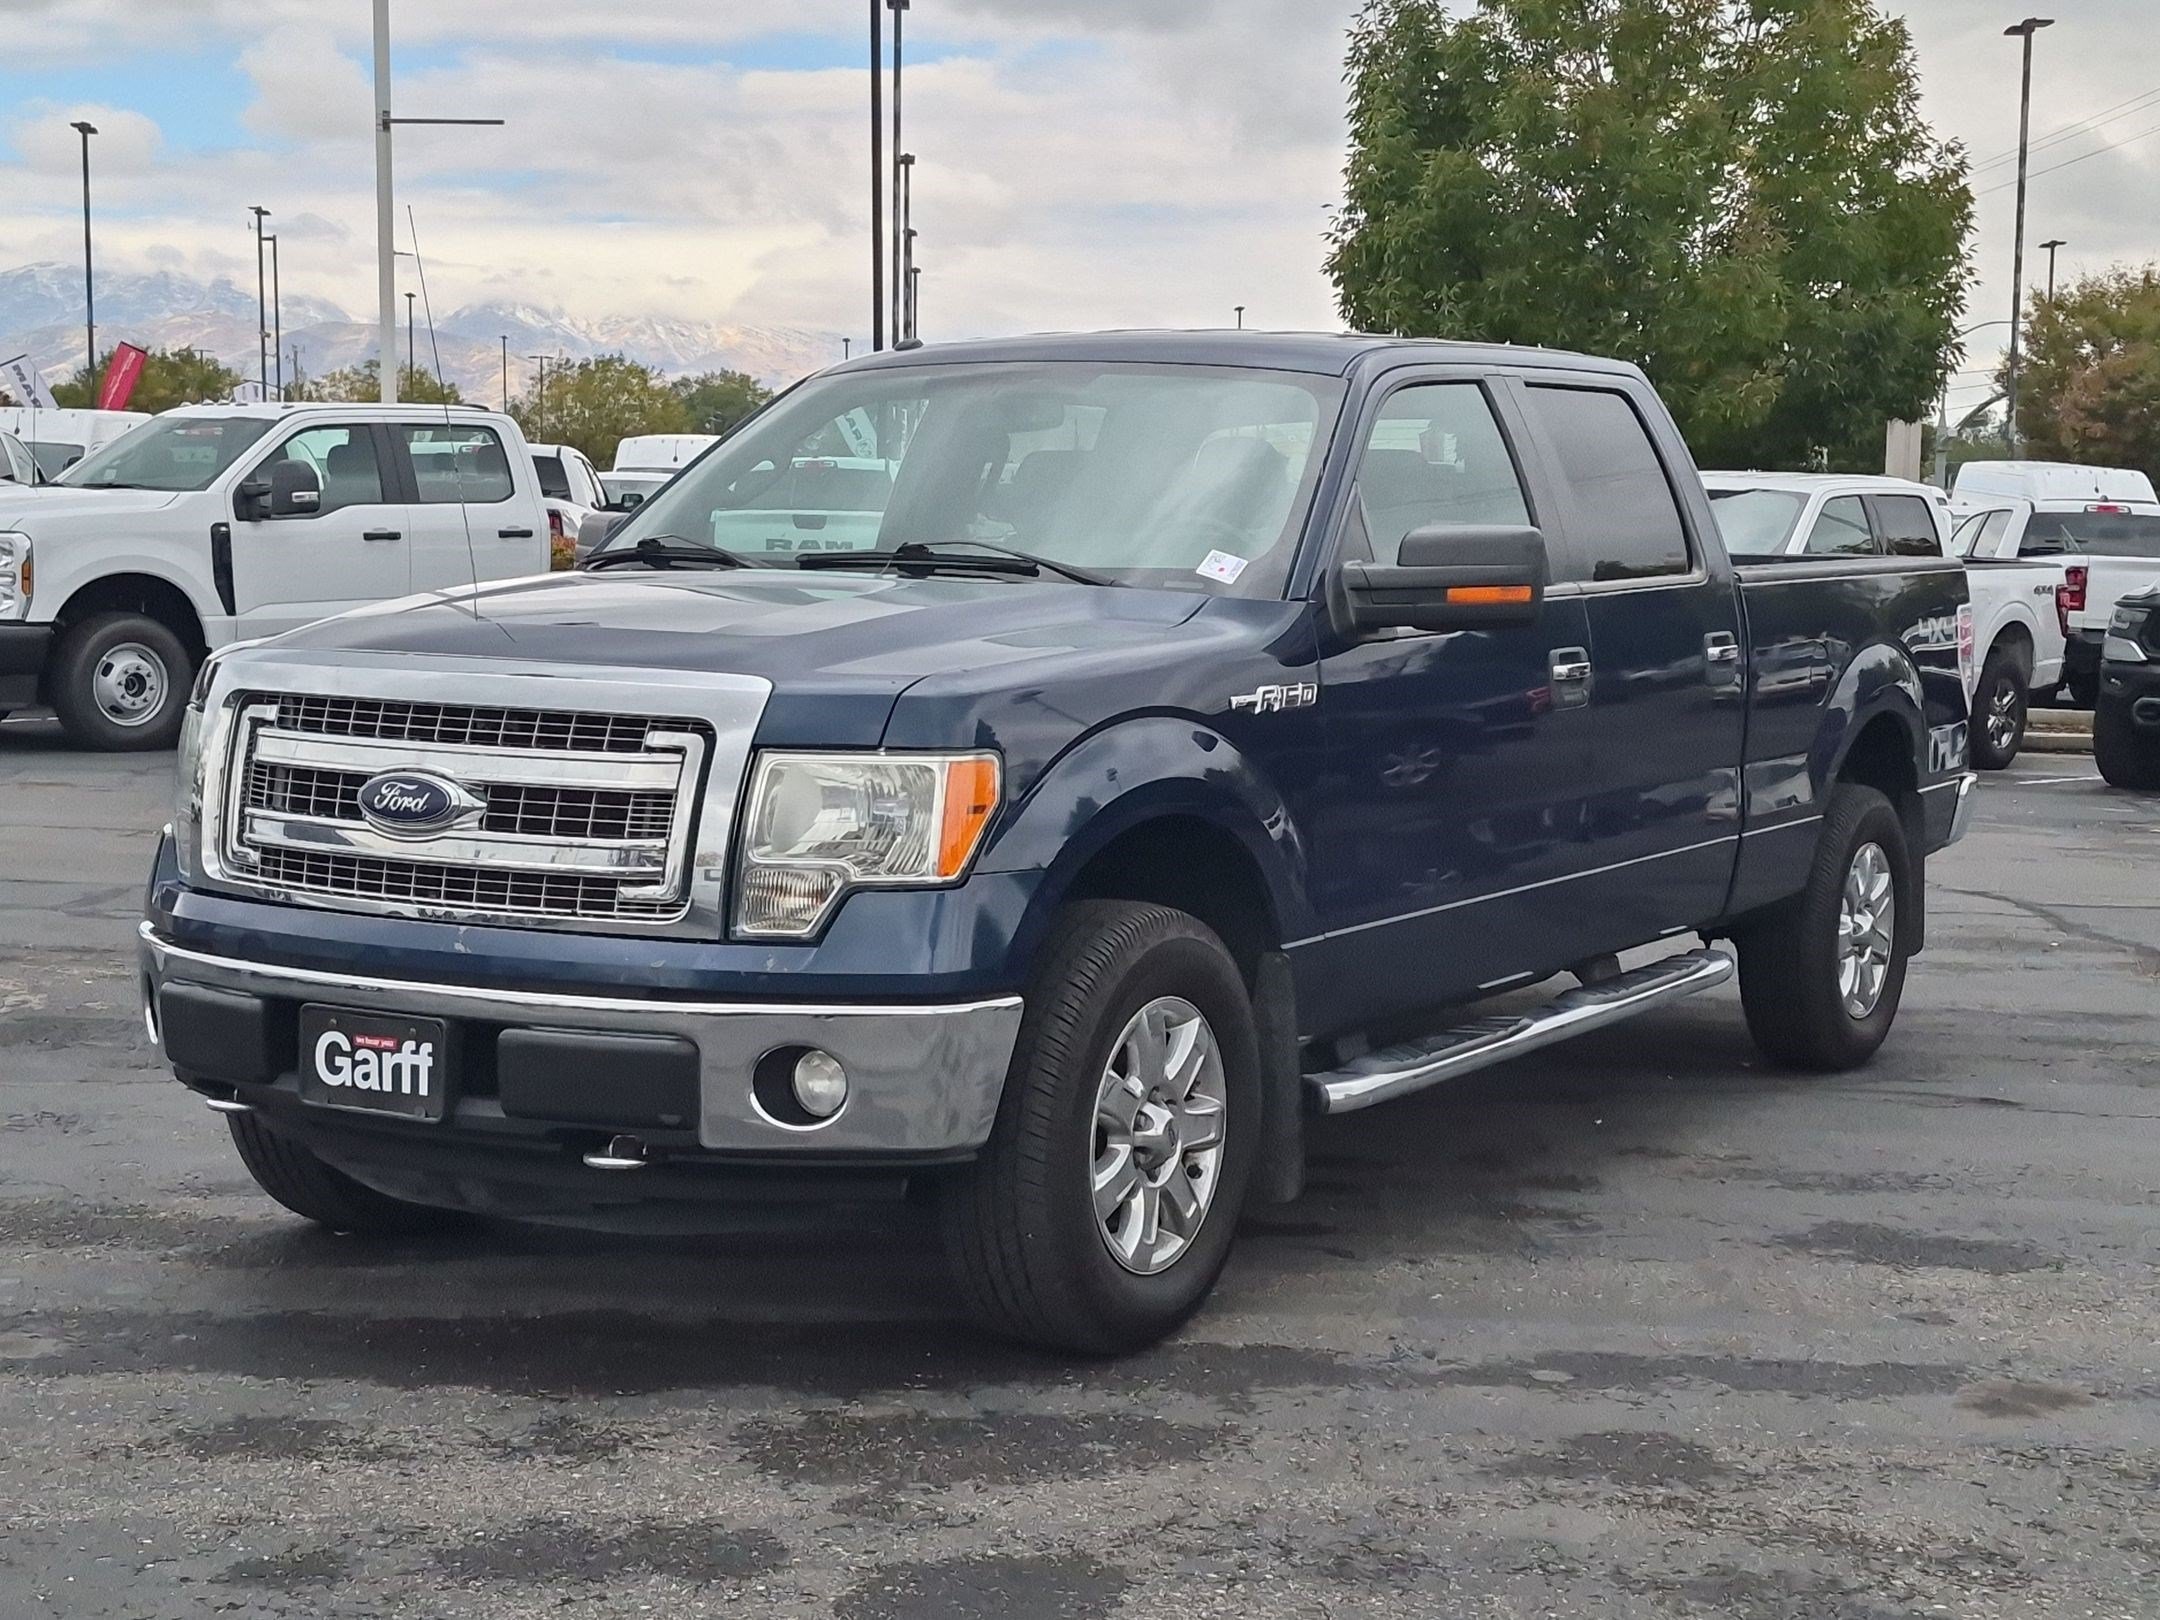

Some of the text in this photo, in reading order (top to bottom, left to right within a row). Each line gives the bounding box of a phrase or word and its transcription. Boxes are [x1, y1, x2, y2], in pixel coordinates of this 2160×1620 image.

[765, 538, 853, 551] RAM
[374, 781, 431, 812] Ford
[315, 1030, 433, 1097] Garff
